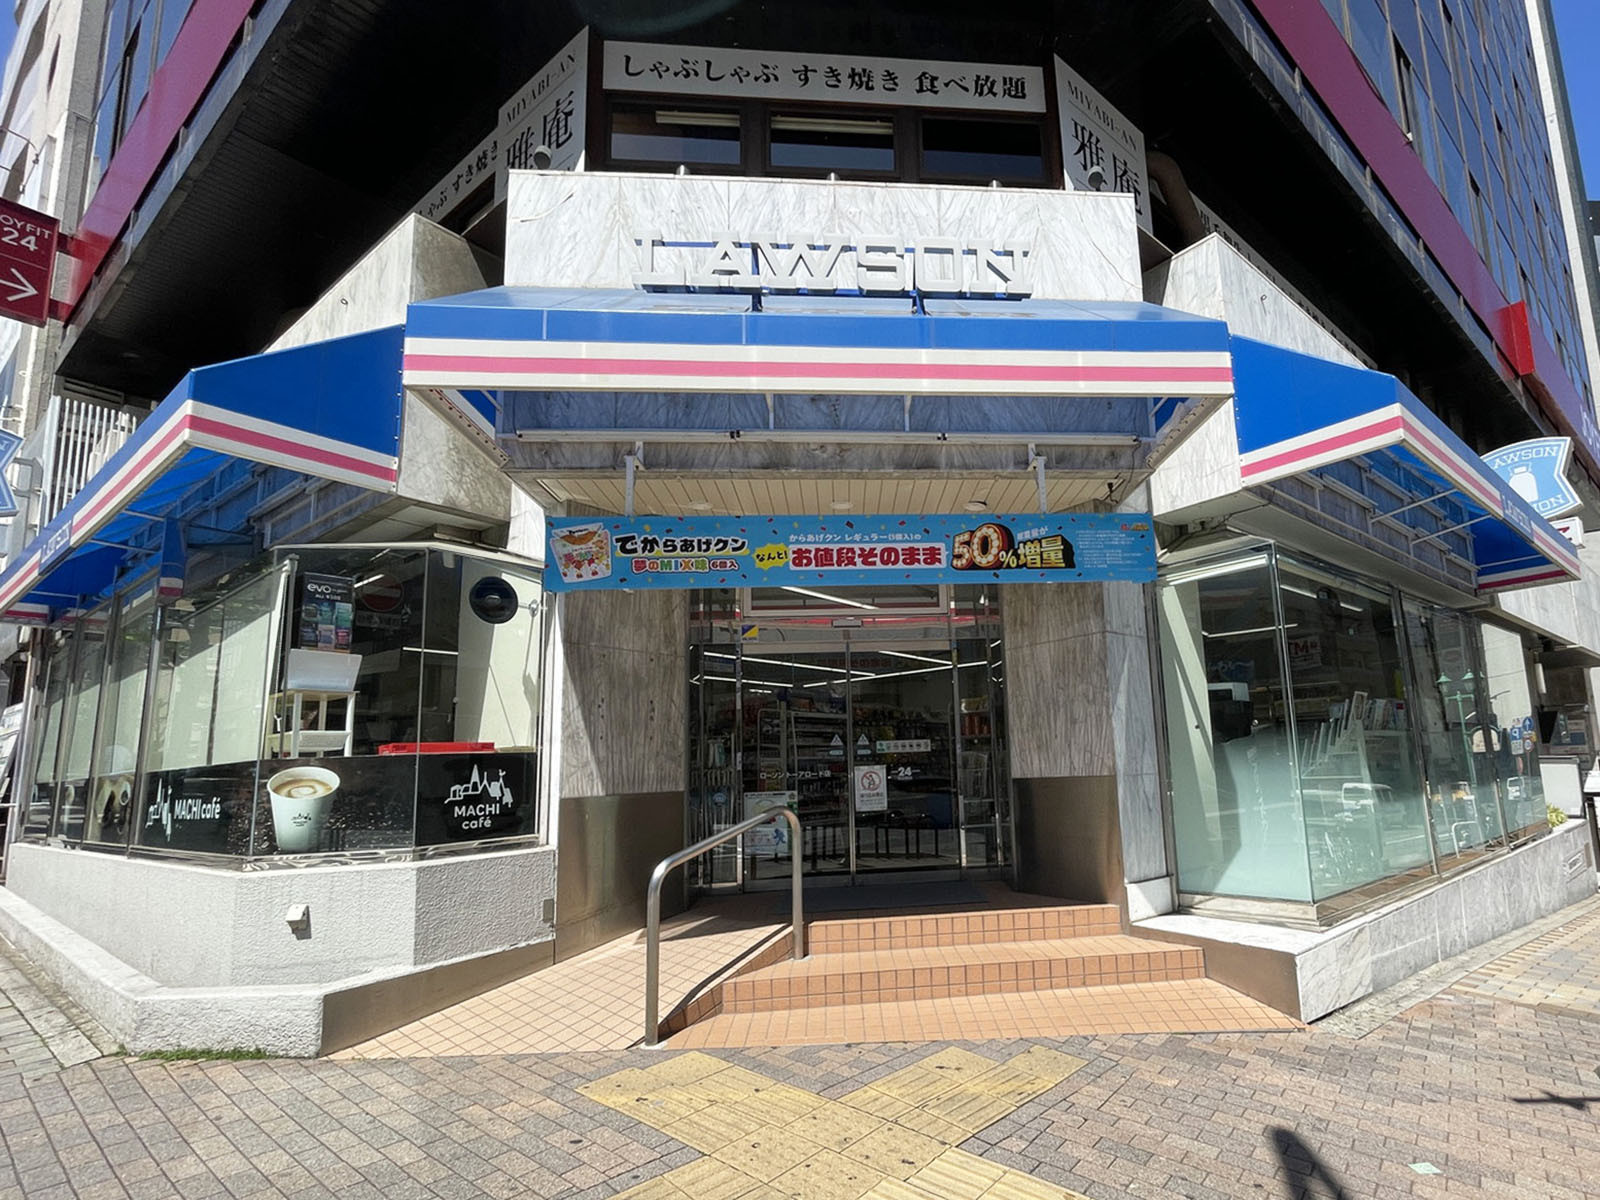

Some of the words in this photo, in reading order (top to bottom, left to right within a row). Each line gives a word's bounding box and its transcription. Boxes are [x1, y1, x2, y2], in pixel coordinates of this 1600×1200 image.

[624, 55, 779, 84] しゃぶしゃぶ
[792, 65, 899, 92] すき焼き
[914, 71, 1027, 99] 食べ放題
[1067, 80, 1137, 150] MIYABI-AN
[2, 226, 38, 251] 24
[632, 230, 1033, 295] LAWSON
[1493, 446, 1559, 469] AWSON
[614, 534, 748, 554] でからあげクン
[791, 546, 942, 568] お値段そのまま
[307, 583, 331, 593] evo
[898, 766, 913, 777] 24
[173, 798, 202, 819] MACHI
[201, 796, 221, 819] café
[454, 803, 500, 817] MACHI
[462, 816, 492, 829] café
